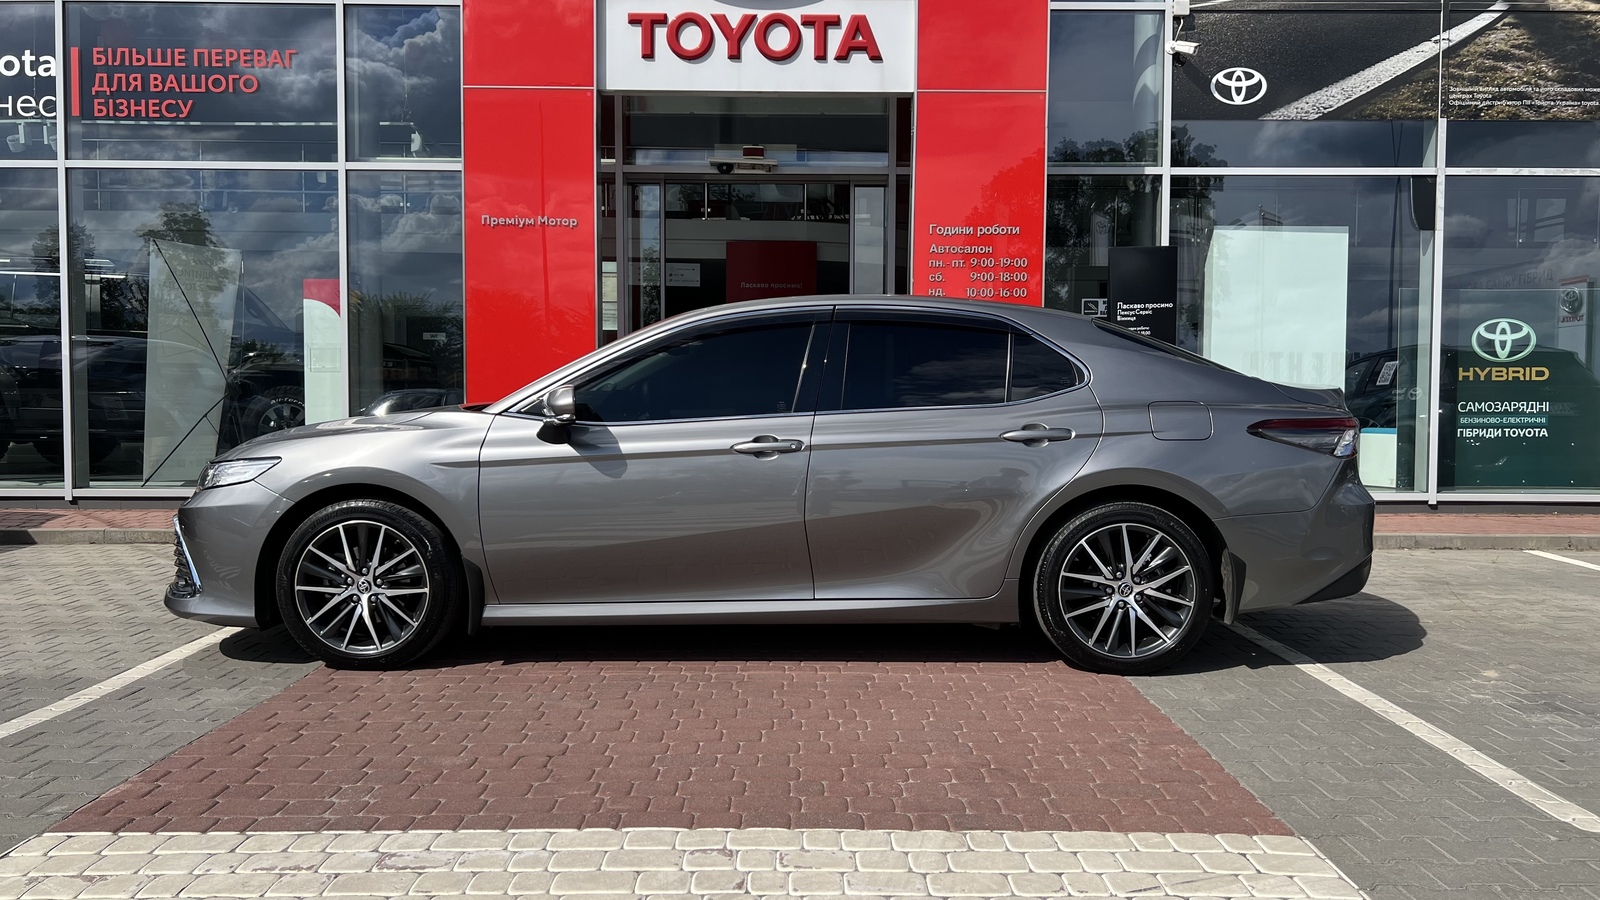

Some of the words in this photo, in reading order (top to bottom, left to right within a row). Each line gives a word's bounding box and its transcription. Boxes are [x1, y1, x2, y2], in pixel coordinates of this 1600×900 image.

[627, 11, 884, 62] TOYOTA
[92, 47, 186, 67] БІЛЬШЕ
[193, 48, 297, 69] ПЕРЕВАГ
[91, 73, 143, 96] ДЛЯ
[149, 73, 260, 94] ВАШОГО
[93, 98, 195, 119] БІЗНЕСУ
[481, 214, 535, 228] Преміум
[537, 215, 578, 229] Мотор
[929, 223, 974, 236] Години
[977, 223, 1020, 237] роботи
[929, 243, 993, 254] Автосалон
[970, 257, 1028, 268] 9:00-19:00
[928, 271, 945, 282] сб.
[970, 271, 1028, 282] 9:00-18:00
[966, 287, 1027, 298] 10:00-16:00
[1458, 367, 1550, 381] HYBRID
[1457, 401, 1550, 413] САМОЗАРЯДНІ
[1457, 428, 1502, 438] ГІБРИДИ
[1503, 428, 1548, 437] TOYOTA
